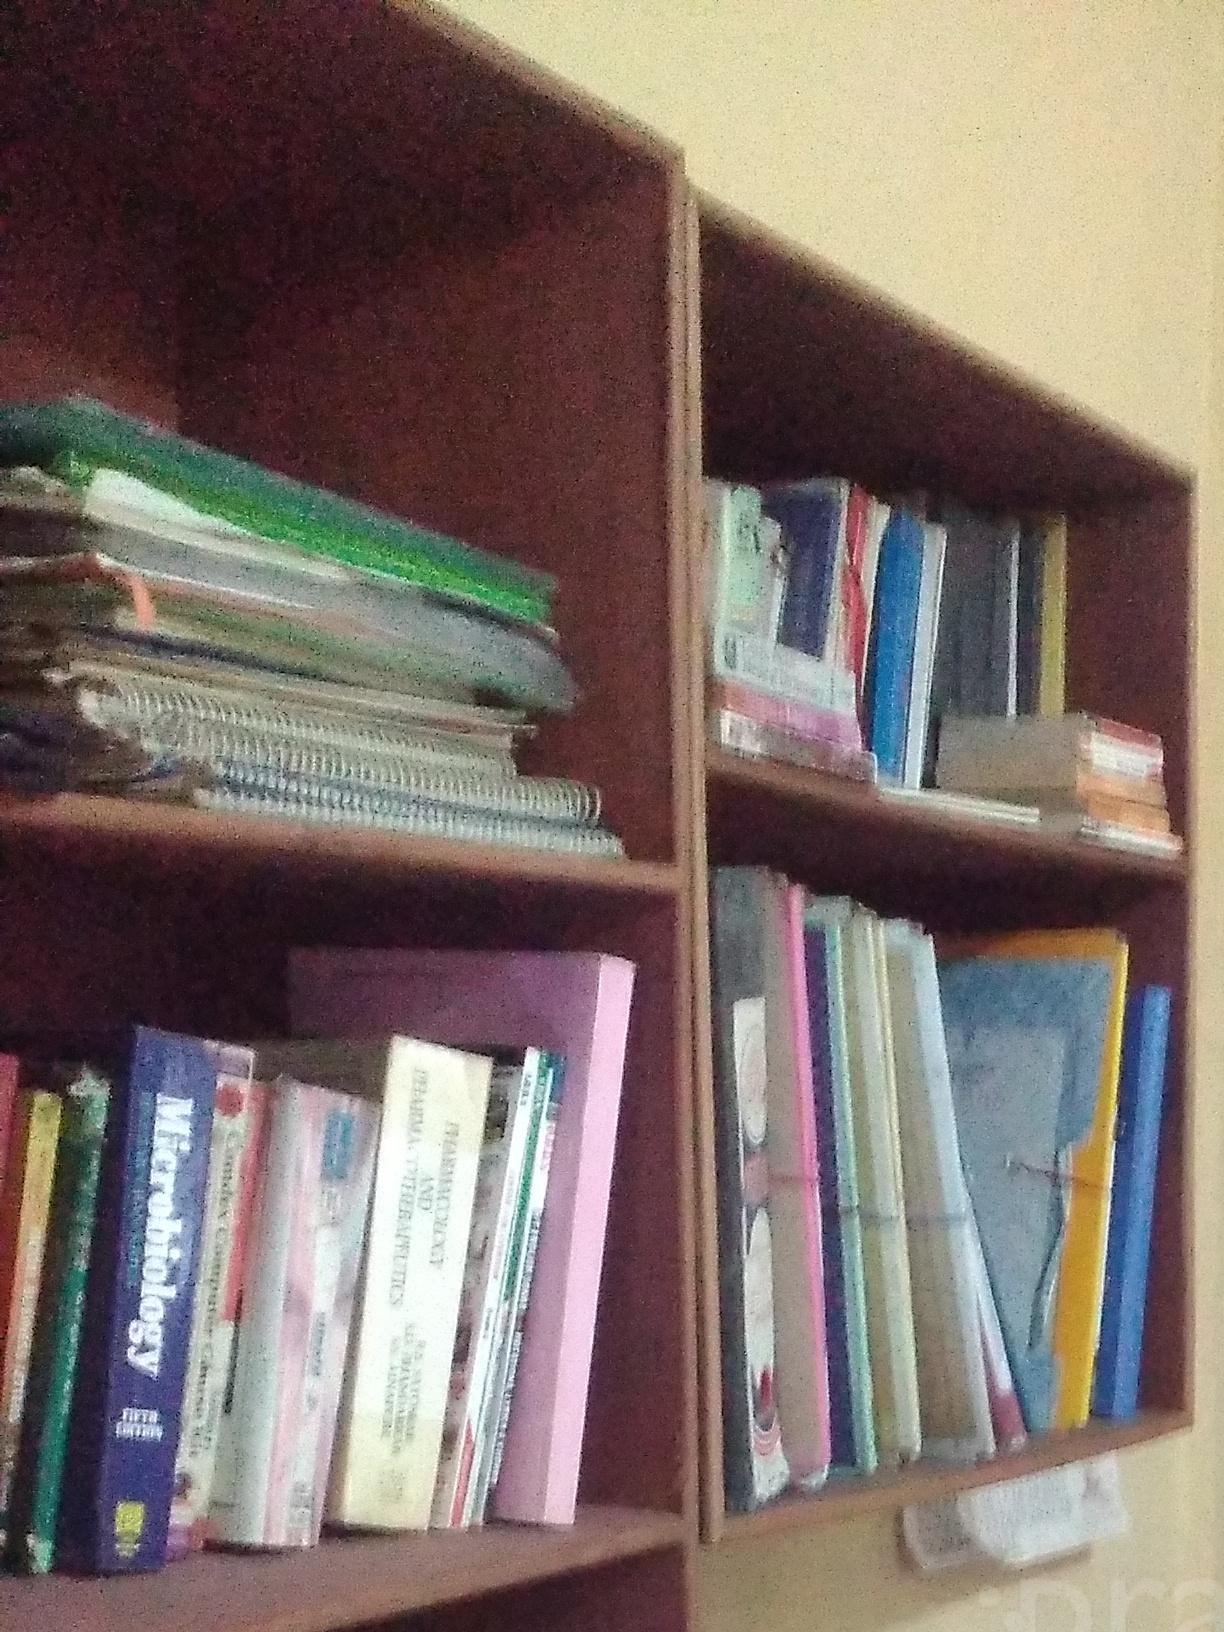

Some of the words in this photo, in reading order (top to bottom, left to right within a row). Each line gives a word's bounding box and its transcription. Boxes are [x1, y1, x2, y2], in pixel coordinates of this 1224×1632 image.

[127, 1092, 193, 1381] Microbiology
[417, 1171, 434, 1211] AND
[429, 1120, 460, 1268] PHARMACOLOGY
